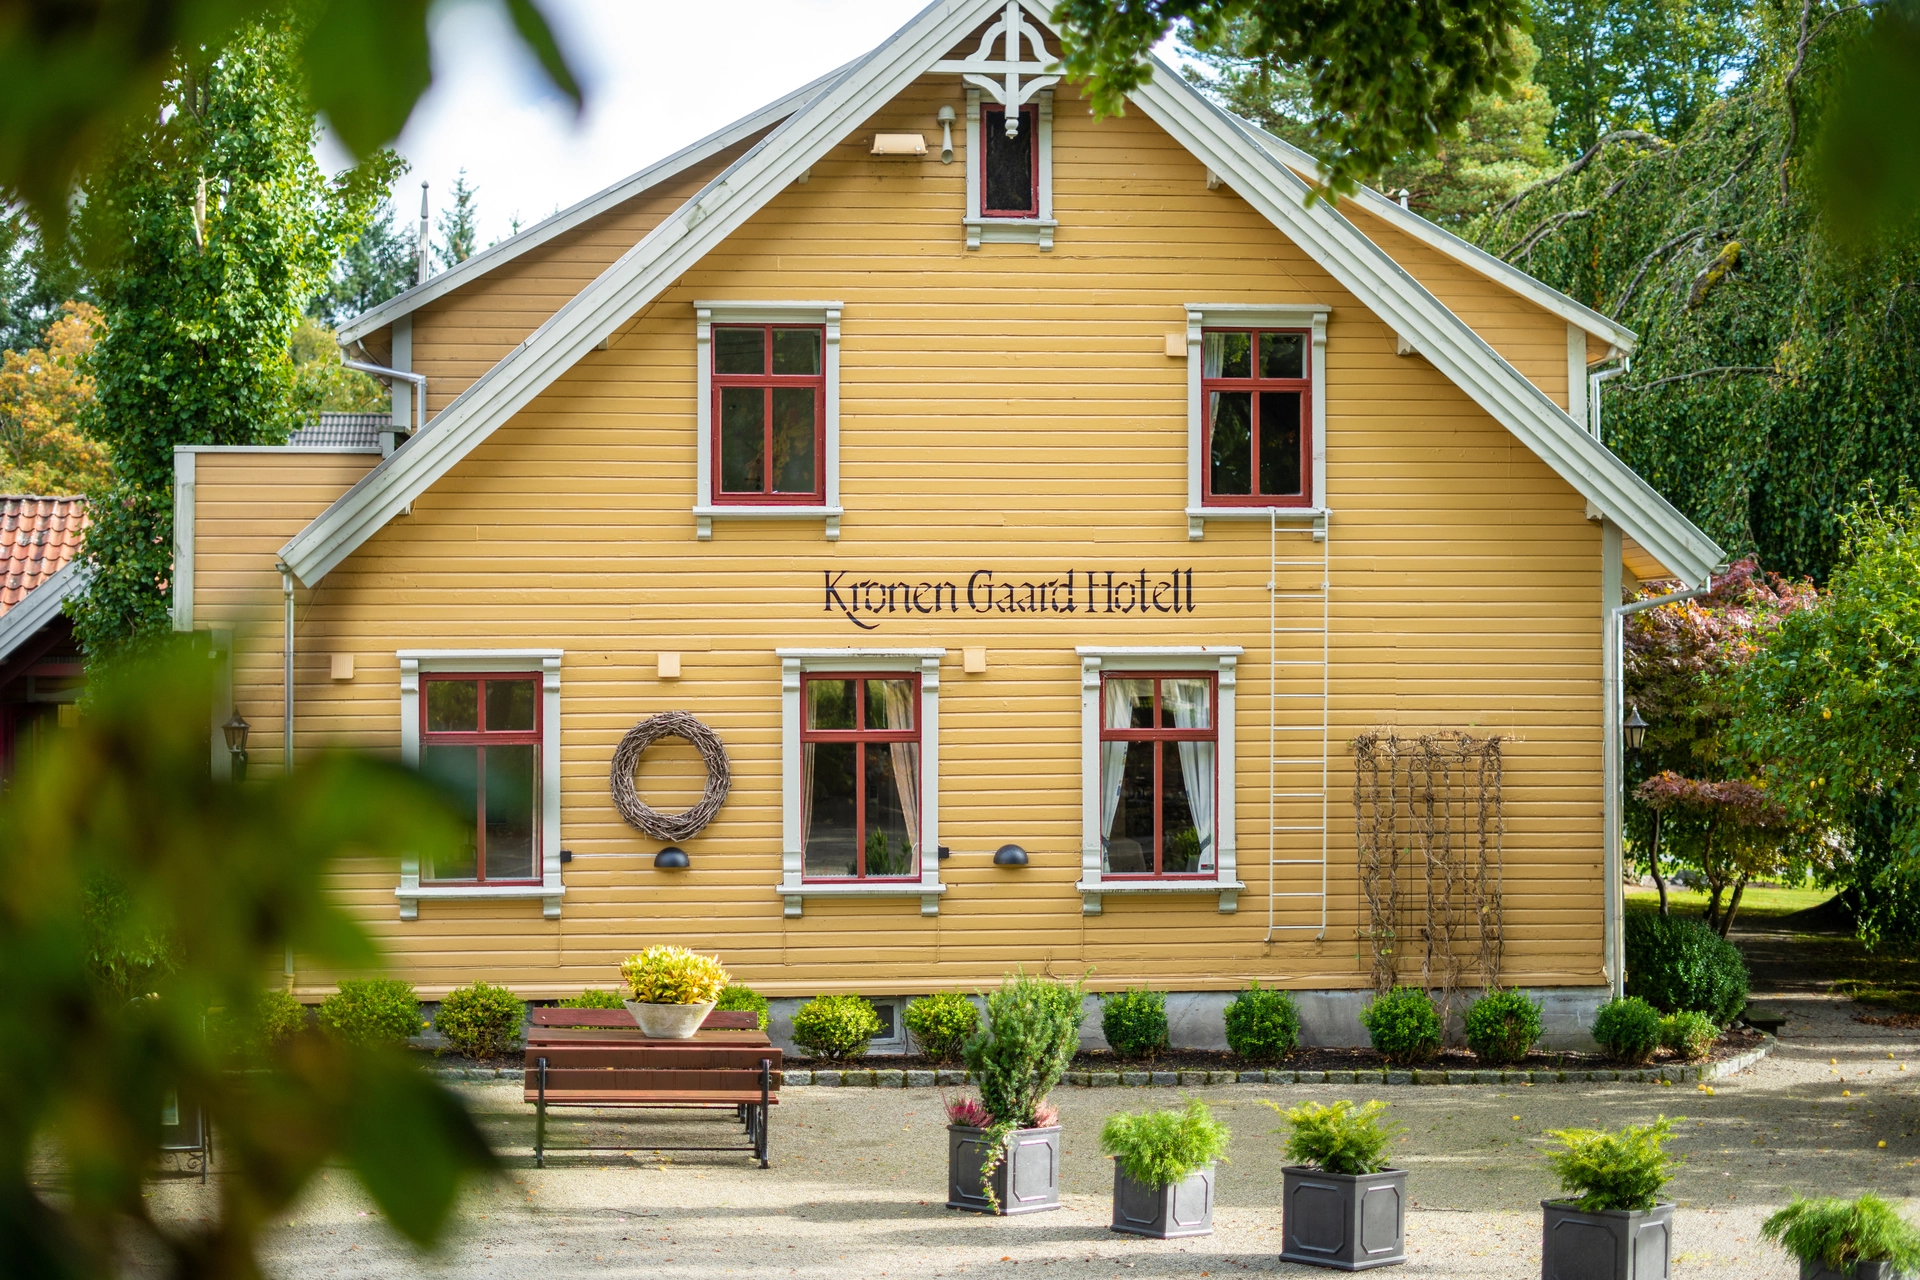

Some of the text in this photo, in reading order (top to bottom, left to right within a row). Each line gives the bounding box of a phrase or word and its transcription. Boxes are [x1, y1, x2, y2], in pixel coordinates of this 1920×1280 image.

[823, 567, 1196, 629] Kronen Gaard Hotell
